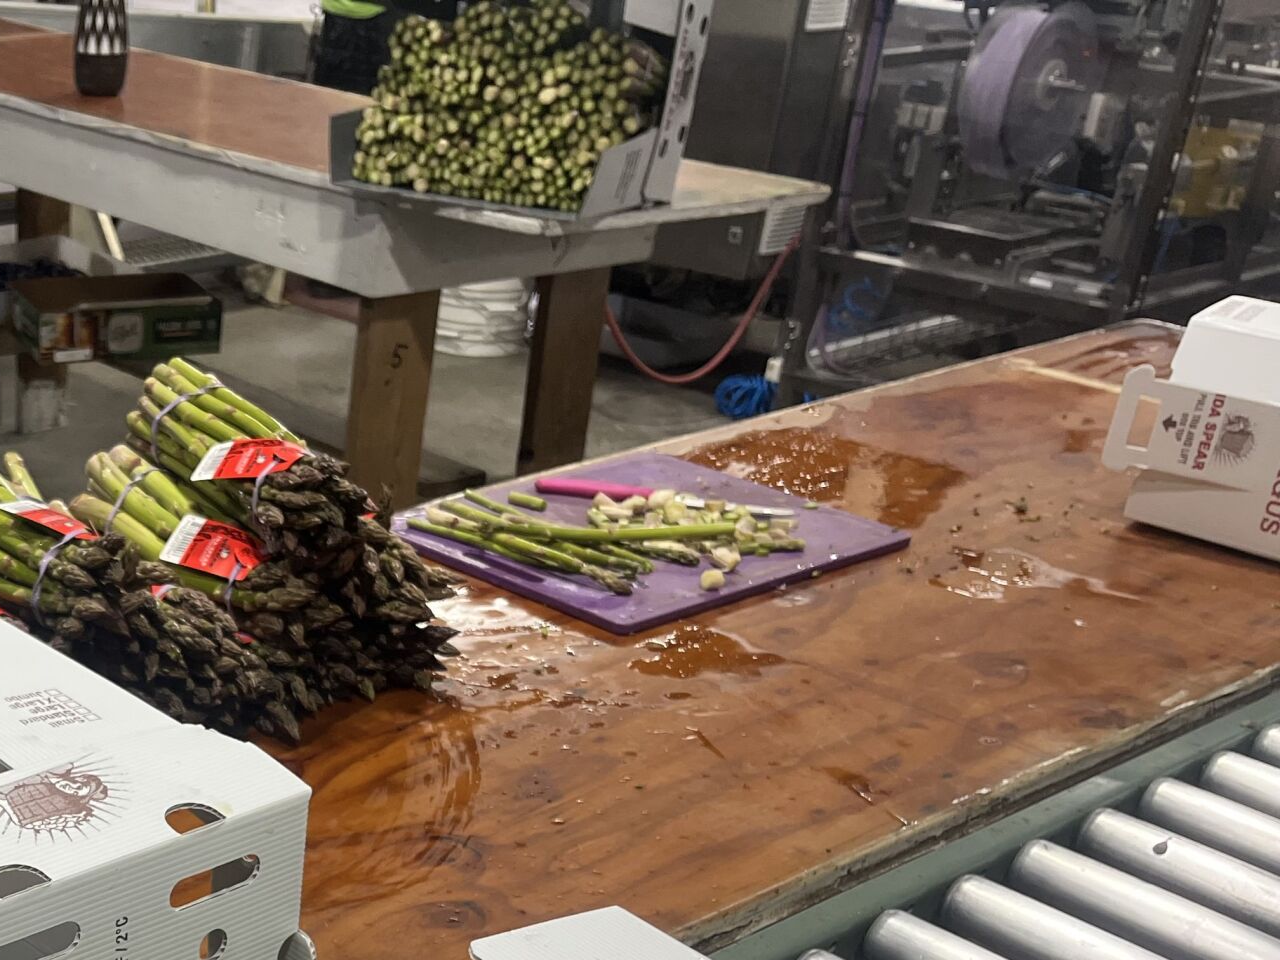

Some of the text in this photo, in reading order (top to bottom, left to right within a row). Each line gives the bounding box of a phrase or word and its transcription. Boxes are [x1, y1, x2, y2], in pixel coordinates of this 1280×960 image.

[390, 342, 409, 369] 5
[1191, 394, 1226, 470] IDA SPEAR
[29, 703, 67, 715] Large
[115, 916, 129, 945] 2°C
